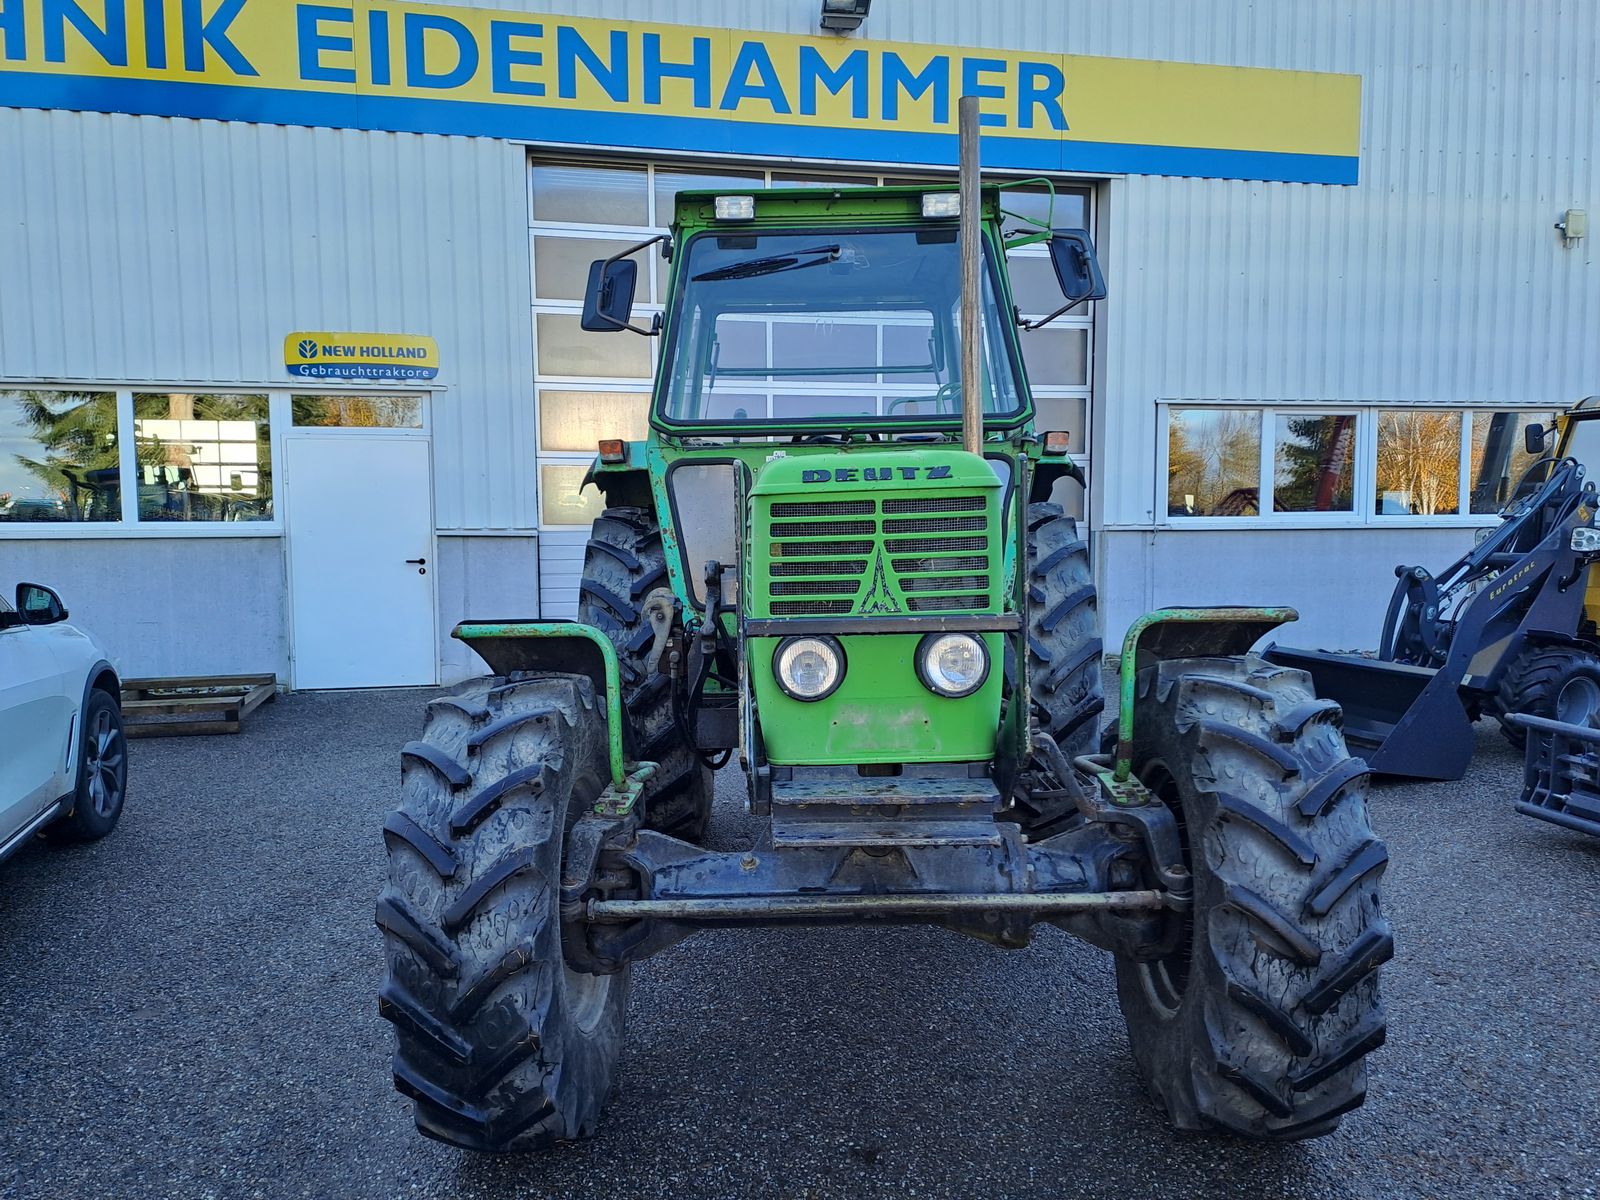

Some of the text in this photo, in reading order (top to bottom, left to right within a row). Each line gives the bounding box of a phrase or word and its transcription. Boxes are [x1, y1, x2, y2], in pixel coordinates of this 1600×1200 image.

[0, 0, 1070, 131] NIK EIDENHAMMER
[322, 345, 427, 358] NEW HOLLAND
[299, 365, 429, 377] Gebrauchttraktore
[802, 465, 953, 483] DEUTZ
[1489, 561, 1536, 600] Eurotrac
